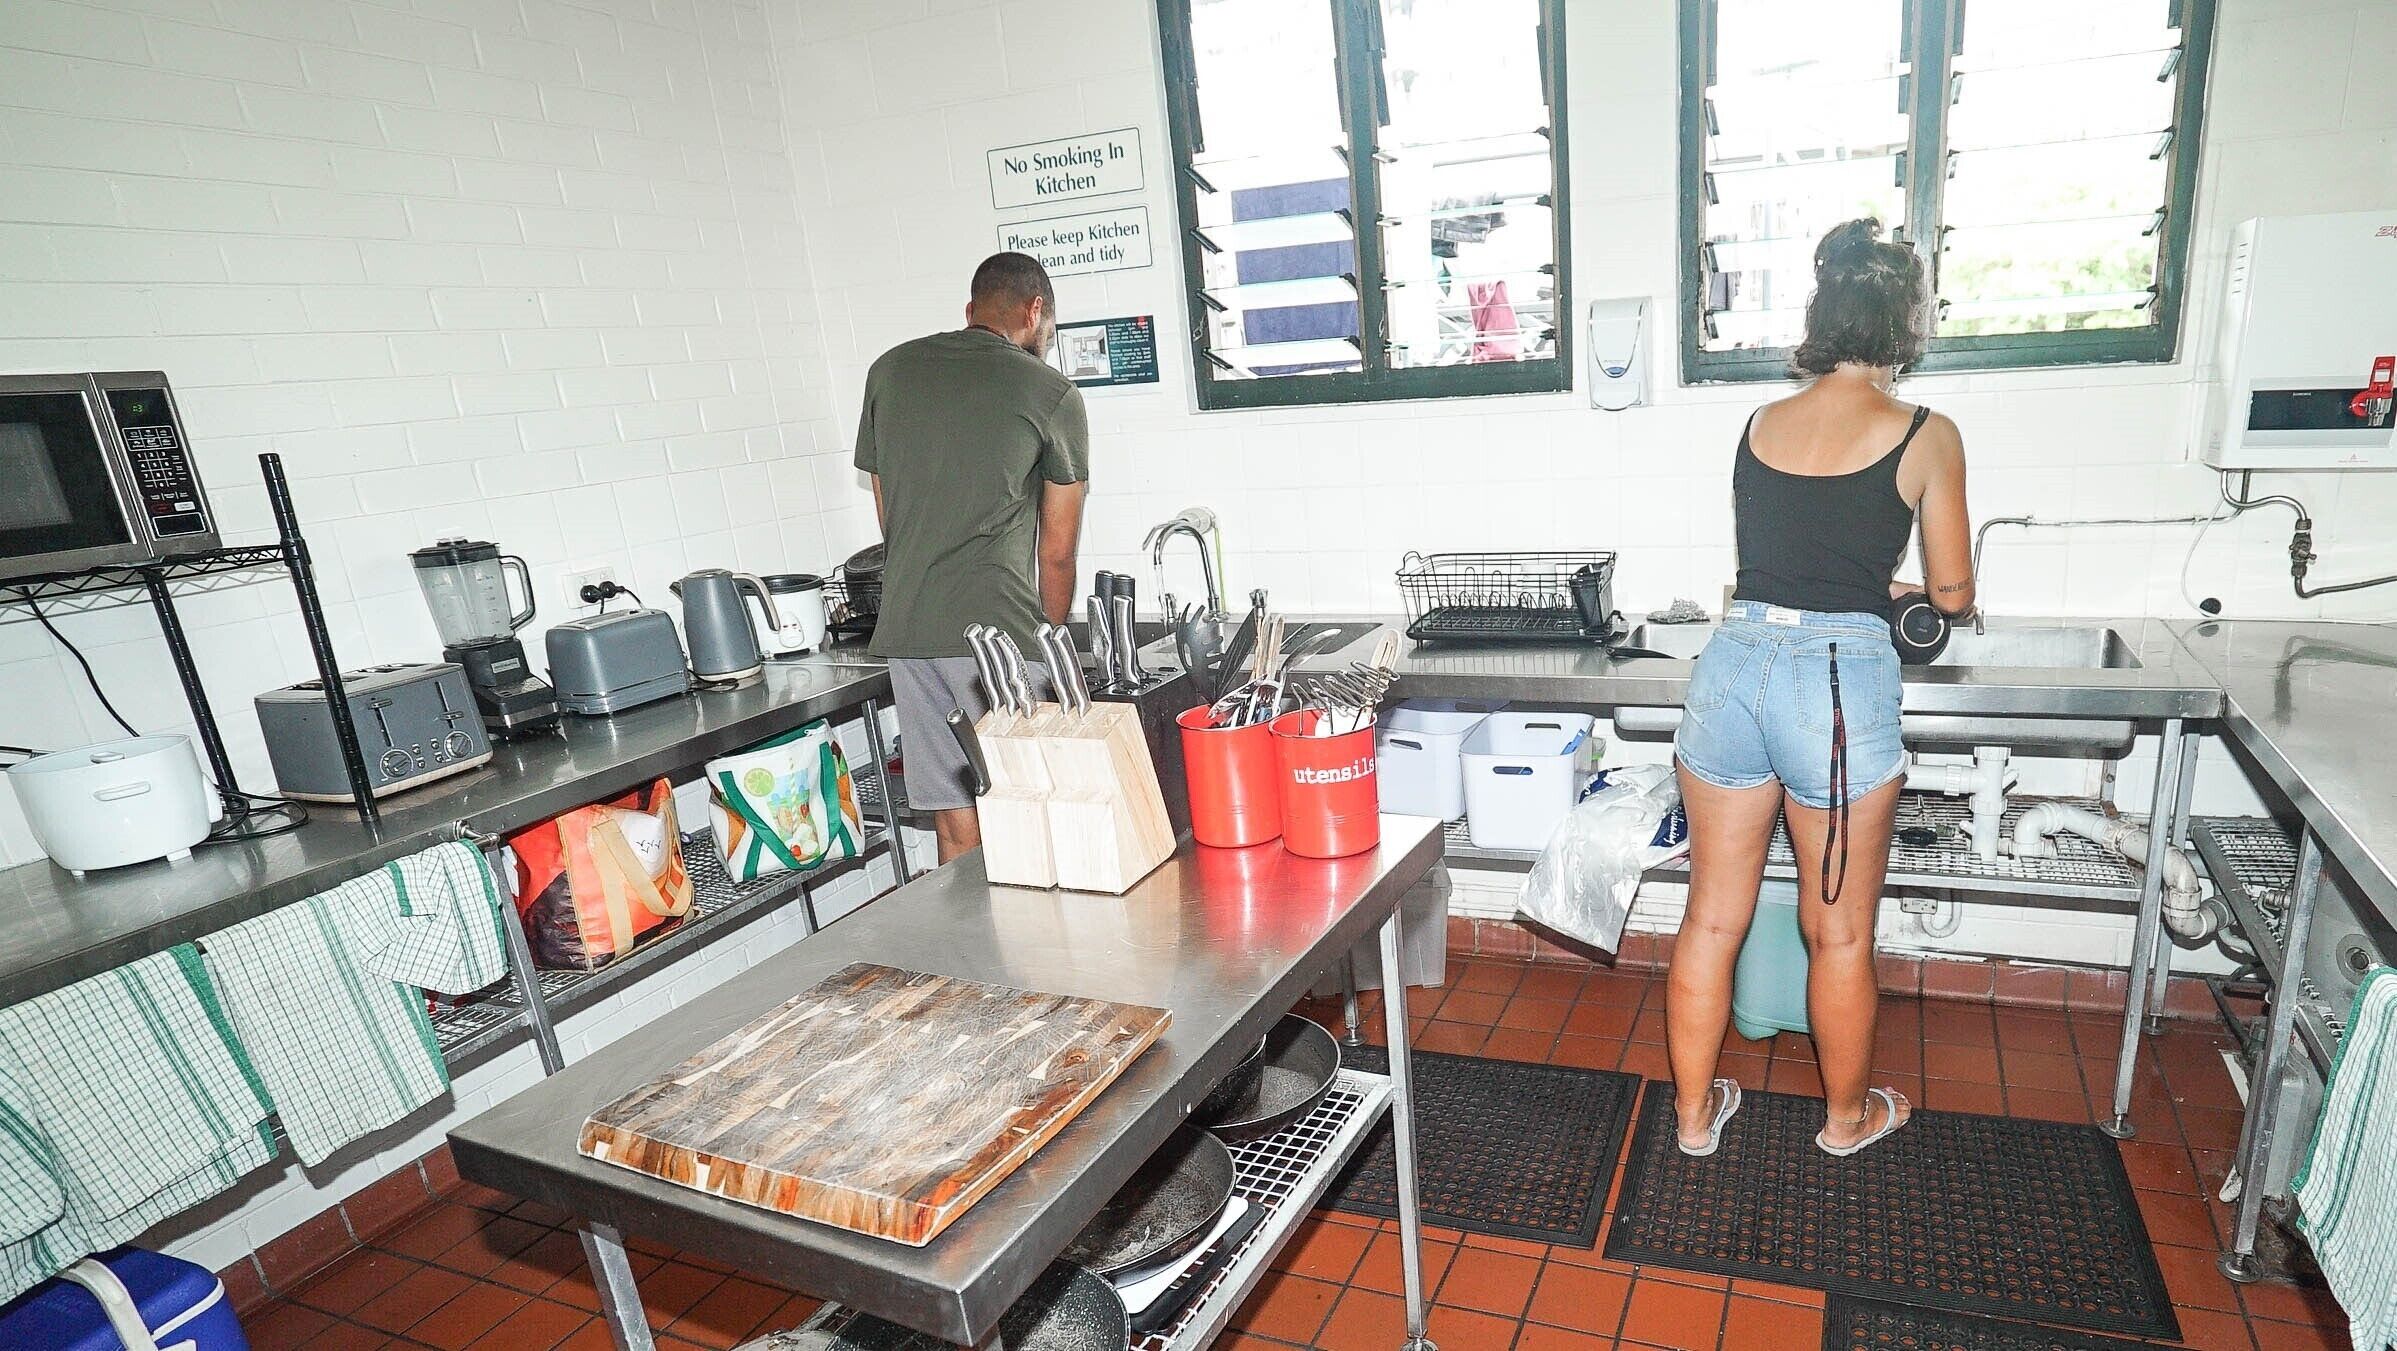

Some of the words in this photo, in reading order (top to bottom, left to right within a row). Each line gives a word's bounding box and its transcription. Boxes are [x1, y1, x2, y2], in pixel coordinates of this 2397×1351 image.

[1004, 156, 1028, 175] No
[1033, 145, 1104, 171] Smoking
[1108, 142, 1124, 160] In
[1035, 172, 1096, 195] Kitchen
[1007, 233, 1048, 250] Please
[1052, 229, 1084, 247] keep
[1088, 221, 1140, 240] Kitchen
[1037, 253, 1065, 268] lean
[1070, 247, 1095, 265] and
[1099, 244, 1125, 264] tidy
[1293, 757, 1375, 784] utensils
